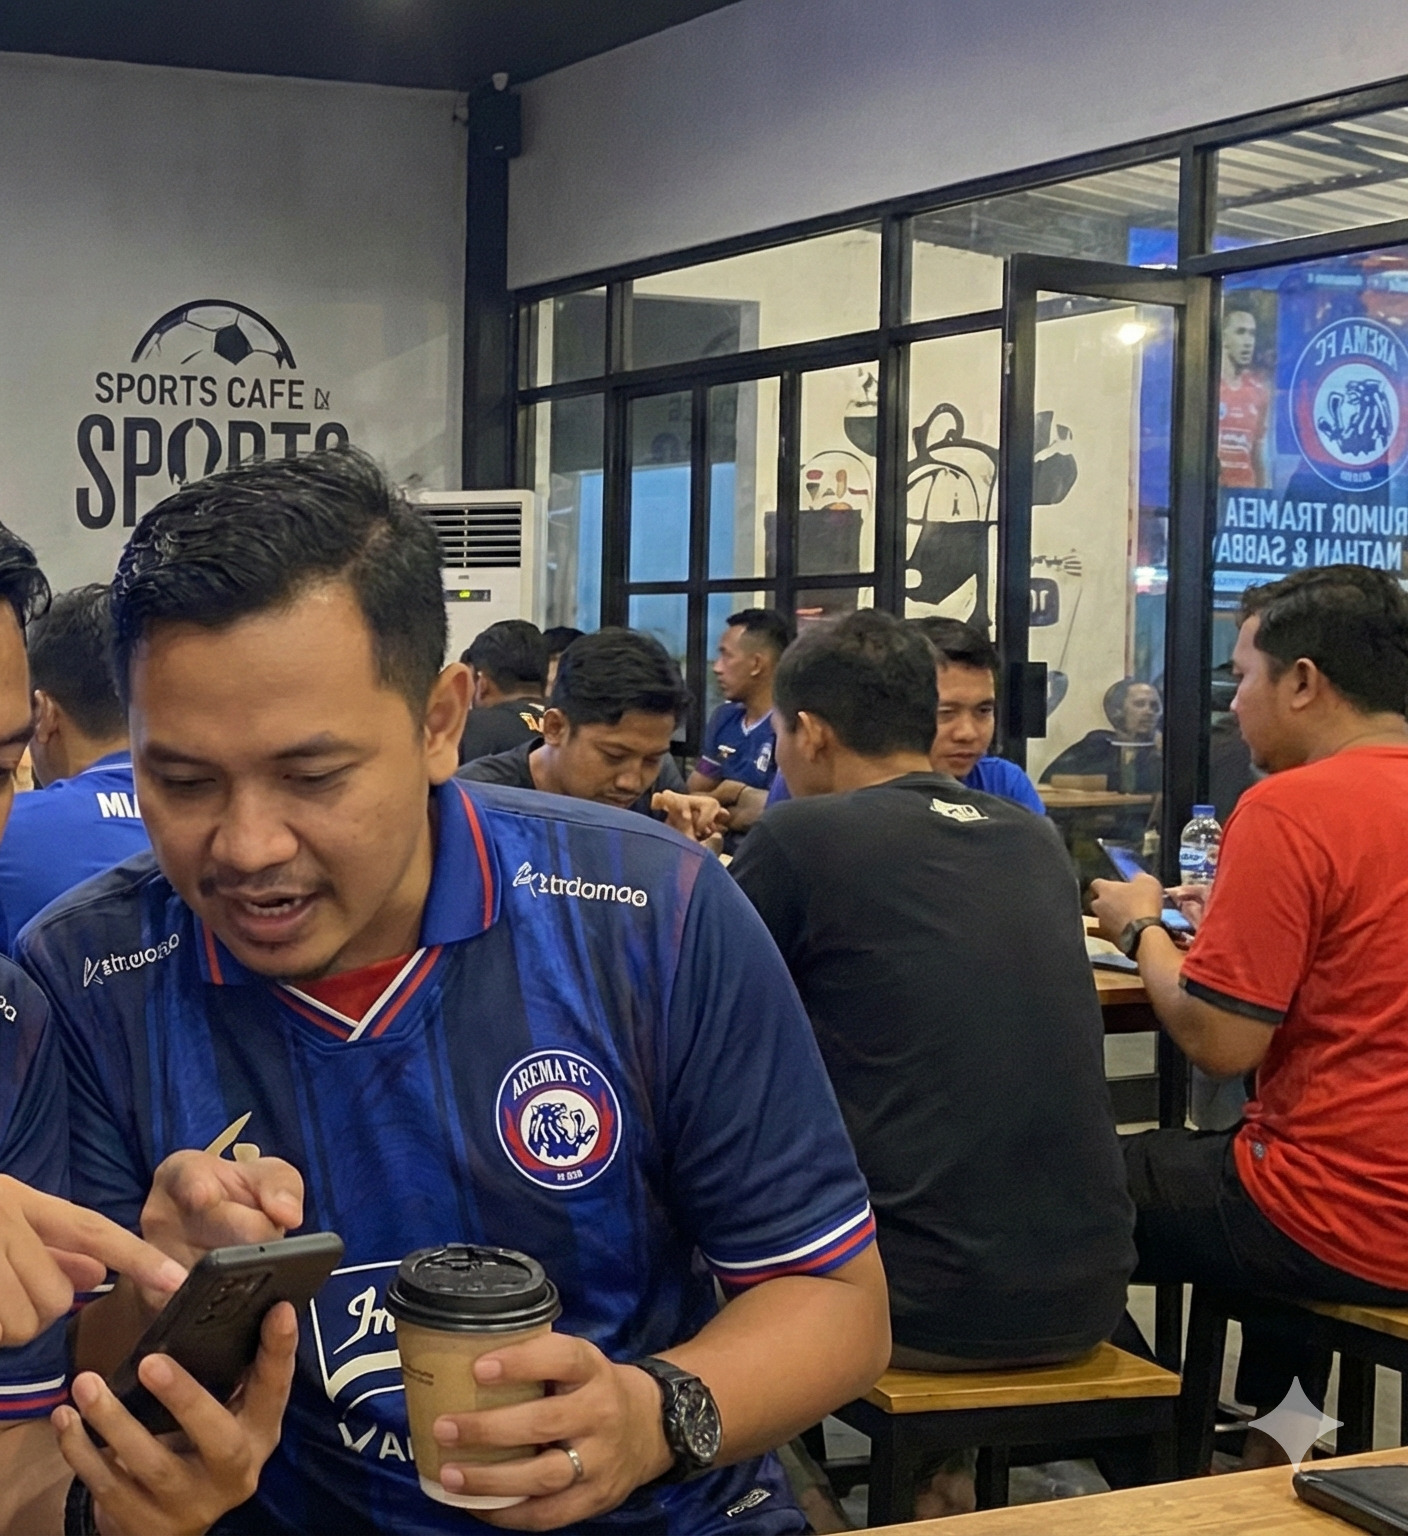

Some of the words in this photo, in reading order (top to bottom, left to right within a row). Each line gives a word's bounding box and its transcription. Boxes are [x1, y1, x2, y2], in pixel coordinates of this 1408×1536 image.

[95, 371, 218, 407] SPORTS
[227, 376, 305, 411] CAFE
[512, 1058, 567, 1101] AREMA
[567, 1060, 591, 1086] FC
